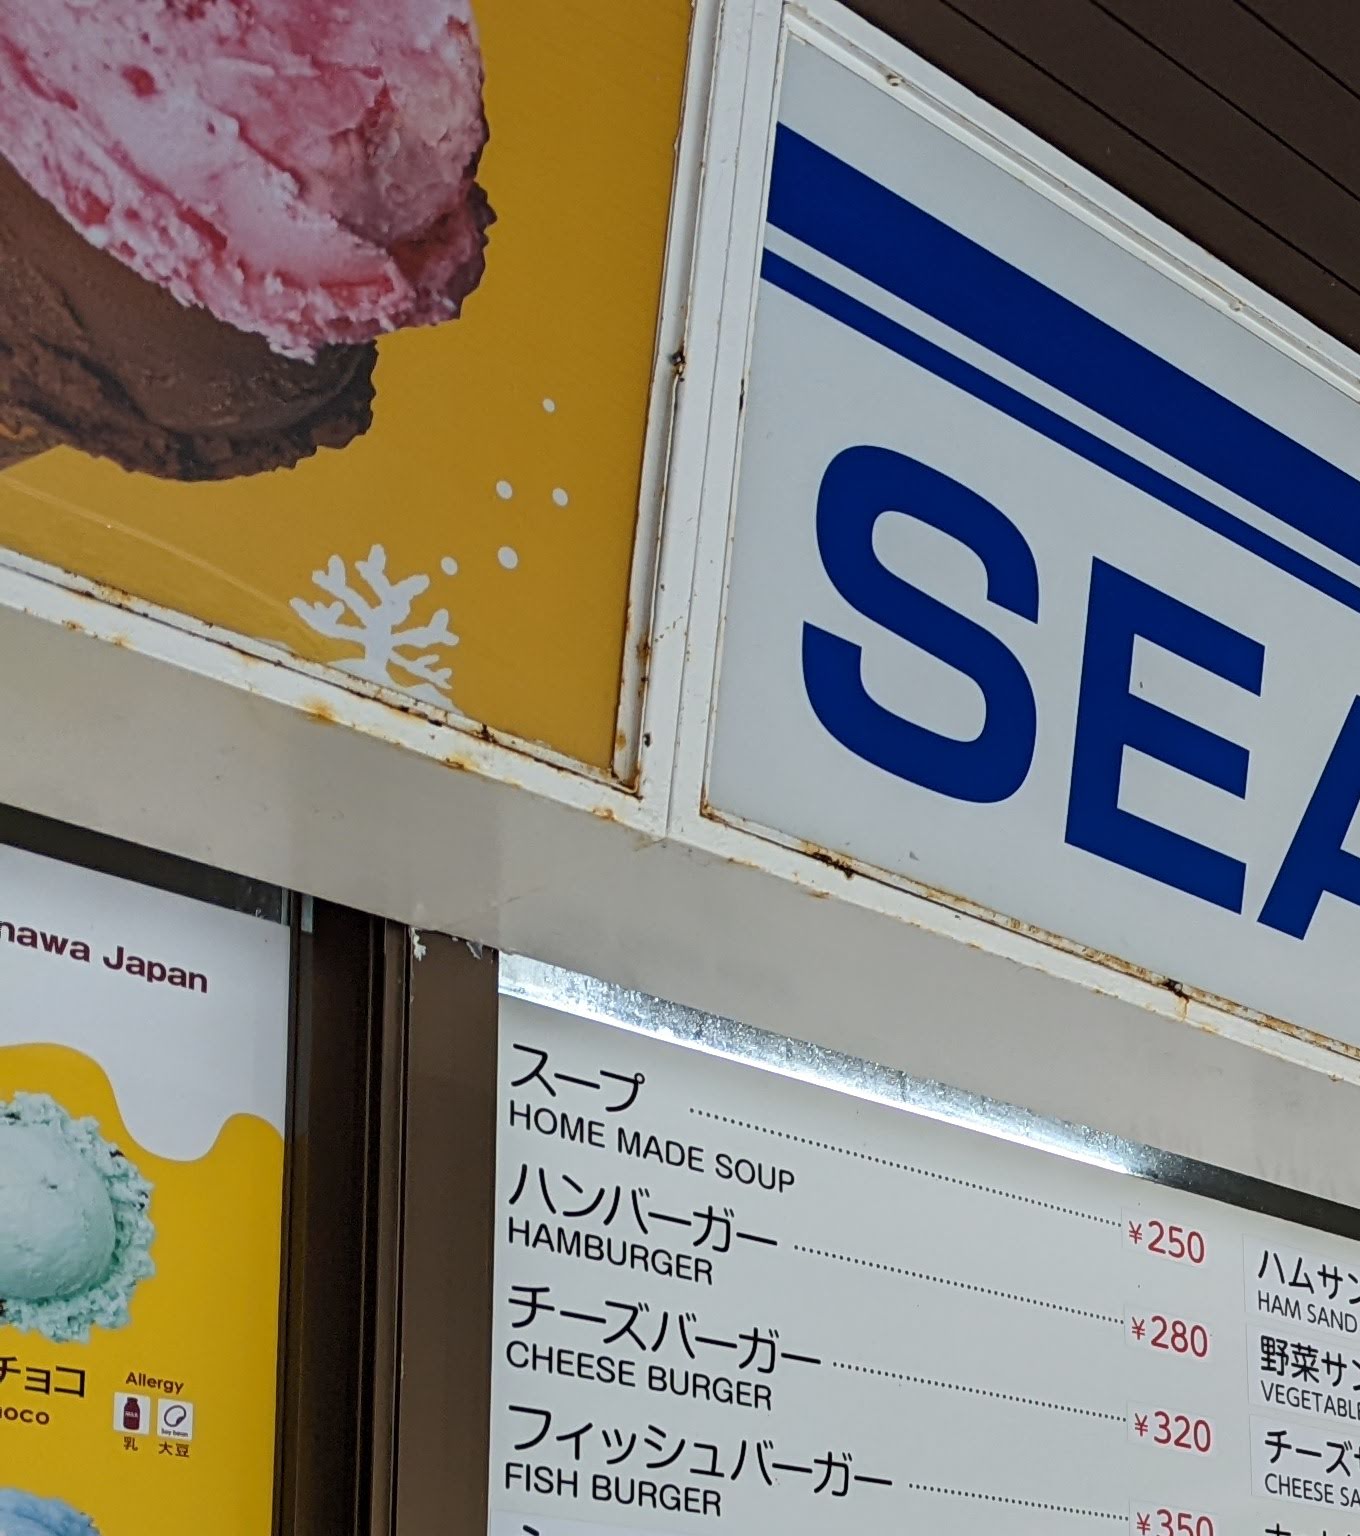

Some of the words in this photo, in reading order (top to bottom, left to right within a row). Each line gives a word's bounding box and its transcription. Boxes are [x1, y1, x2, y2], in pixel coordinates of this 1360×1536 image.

[102, 945, 208, 994] Japan
[508, 1099, 607, 1150] HOME
[615, 1126, 706, 1175] MADE
[714, 1152, 796, 1195] SOUP
[510, 1041, 646, 1115] スープ
[1127, 1215, 1206, 1266] ¥250
[507, 1217, 713, 1287] HAMBURGER
[508, 1162, 779, 1255] ハンバーガー
[1130, 1314, 1209, 1361] ¥280
[1256, 1290, 1304, 1324] HAM
[1307, 1302, 1360, 1335] SAND
[125, 1372, 185, 1395] Allergy
[505, 1339, 637, 1390] CHEESE
[646, 1364, 774, 1412] BURGER
[507, 1283, 822, 1378] チーズバーガー
[1133, 1408, 1212, 1456] ¥320
[123, 1436, 138, 1451] 乳
[158, 1441, 190, 1458] 大豆
[508, 1402, 894, 1501] フィッシュバーガー
[504, 1461, 580, 1501] FISH
[589, 1471, 723, 1519] BURGER
[1264, 1472, 1335, 1508] CHEESE
